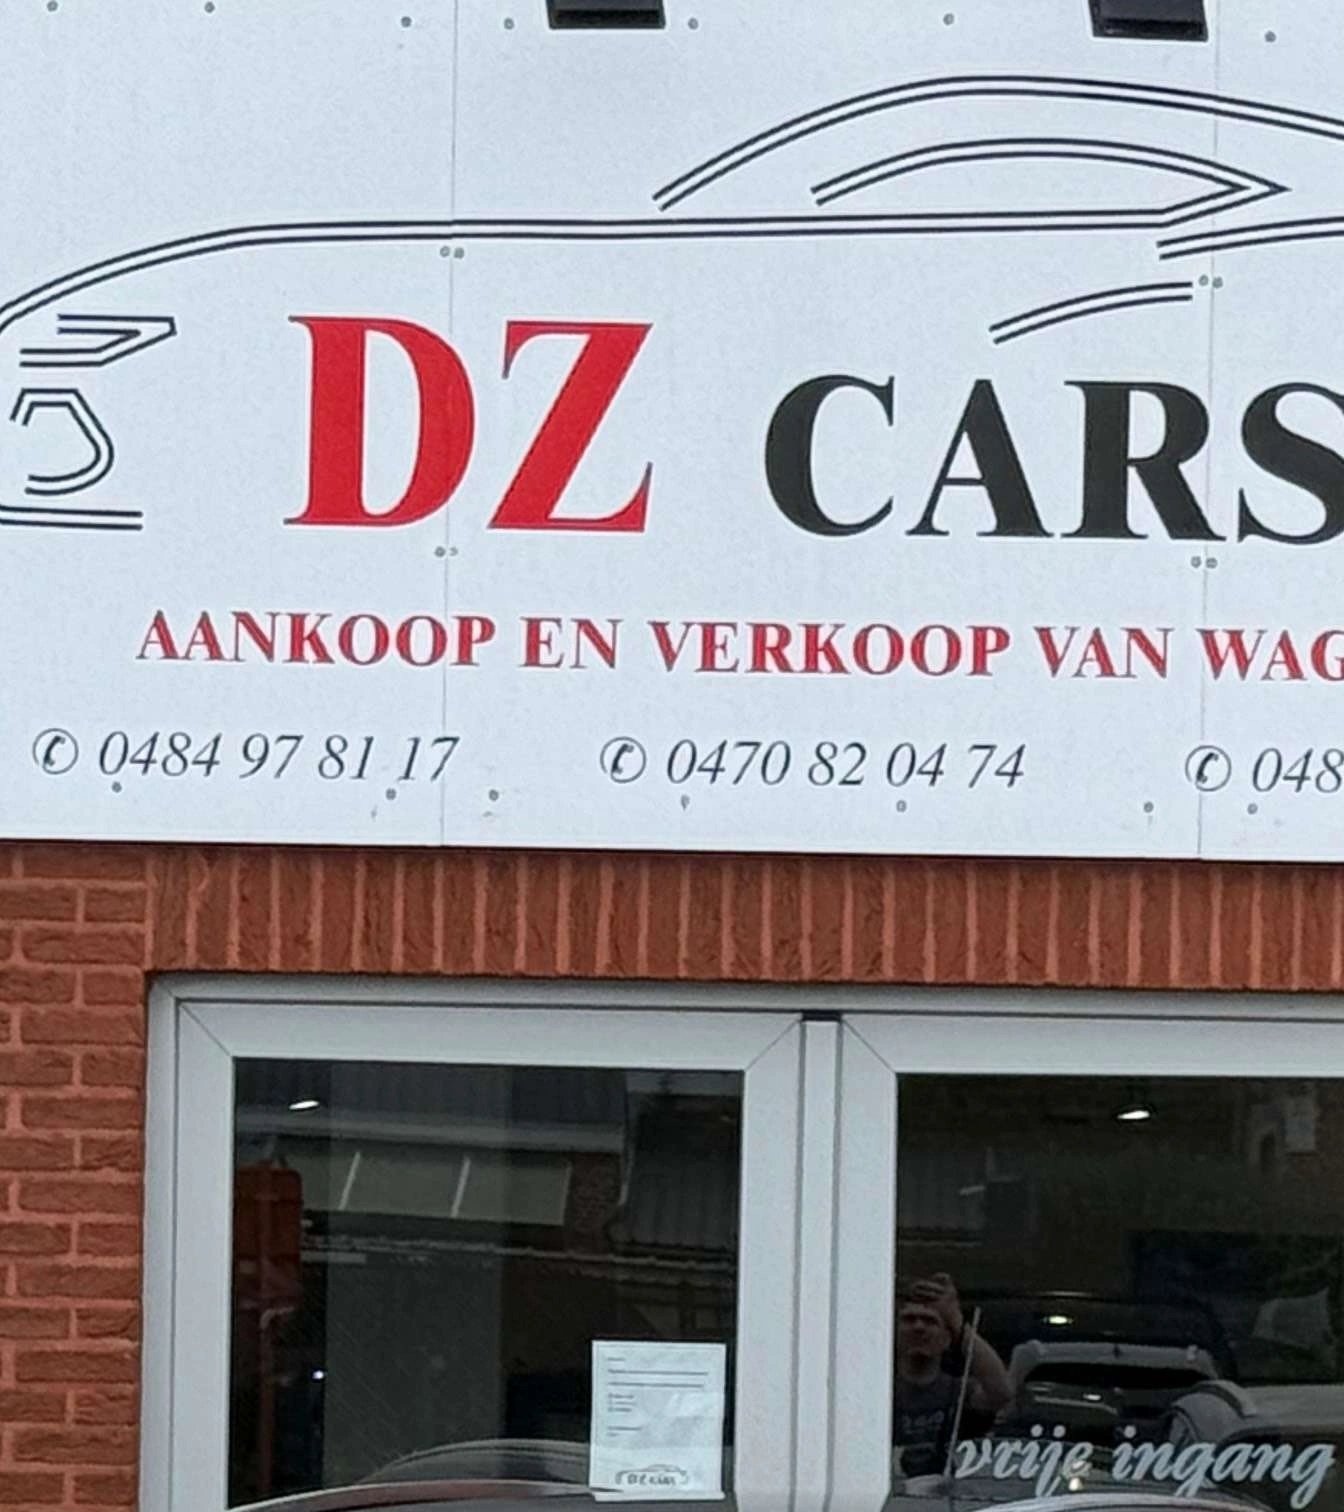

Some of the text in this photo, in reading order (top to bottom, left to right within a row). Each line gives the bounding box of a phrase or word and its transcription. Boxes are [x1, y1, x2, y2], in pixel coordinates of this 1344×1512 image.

[283, 315, 653, 532] DZ
[137, 609, 496, 667] AANKOOP
[519, 616, 621, 670] EN
[648, 620, 1011, 676] VERKOOP
[1033, 624, 1174, 679] VAN
[99, 731, 461, 781] 0484 97 81 17
[666, 739, 1028, 788] 0470 82 04 74
[954, 1424, 1337, 1511] vrije ingang
